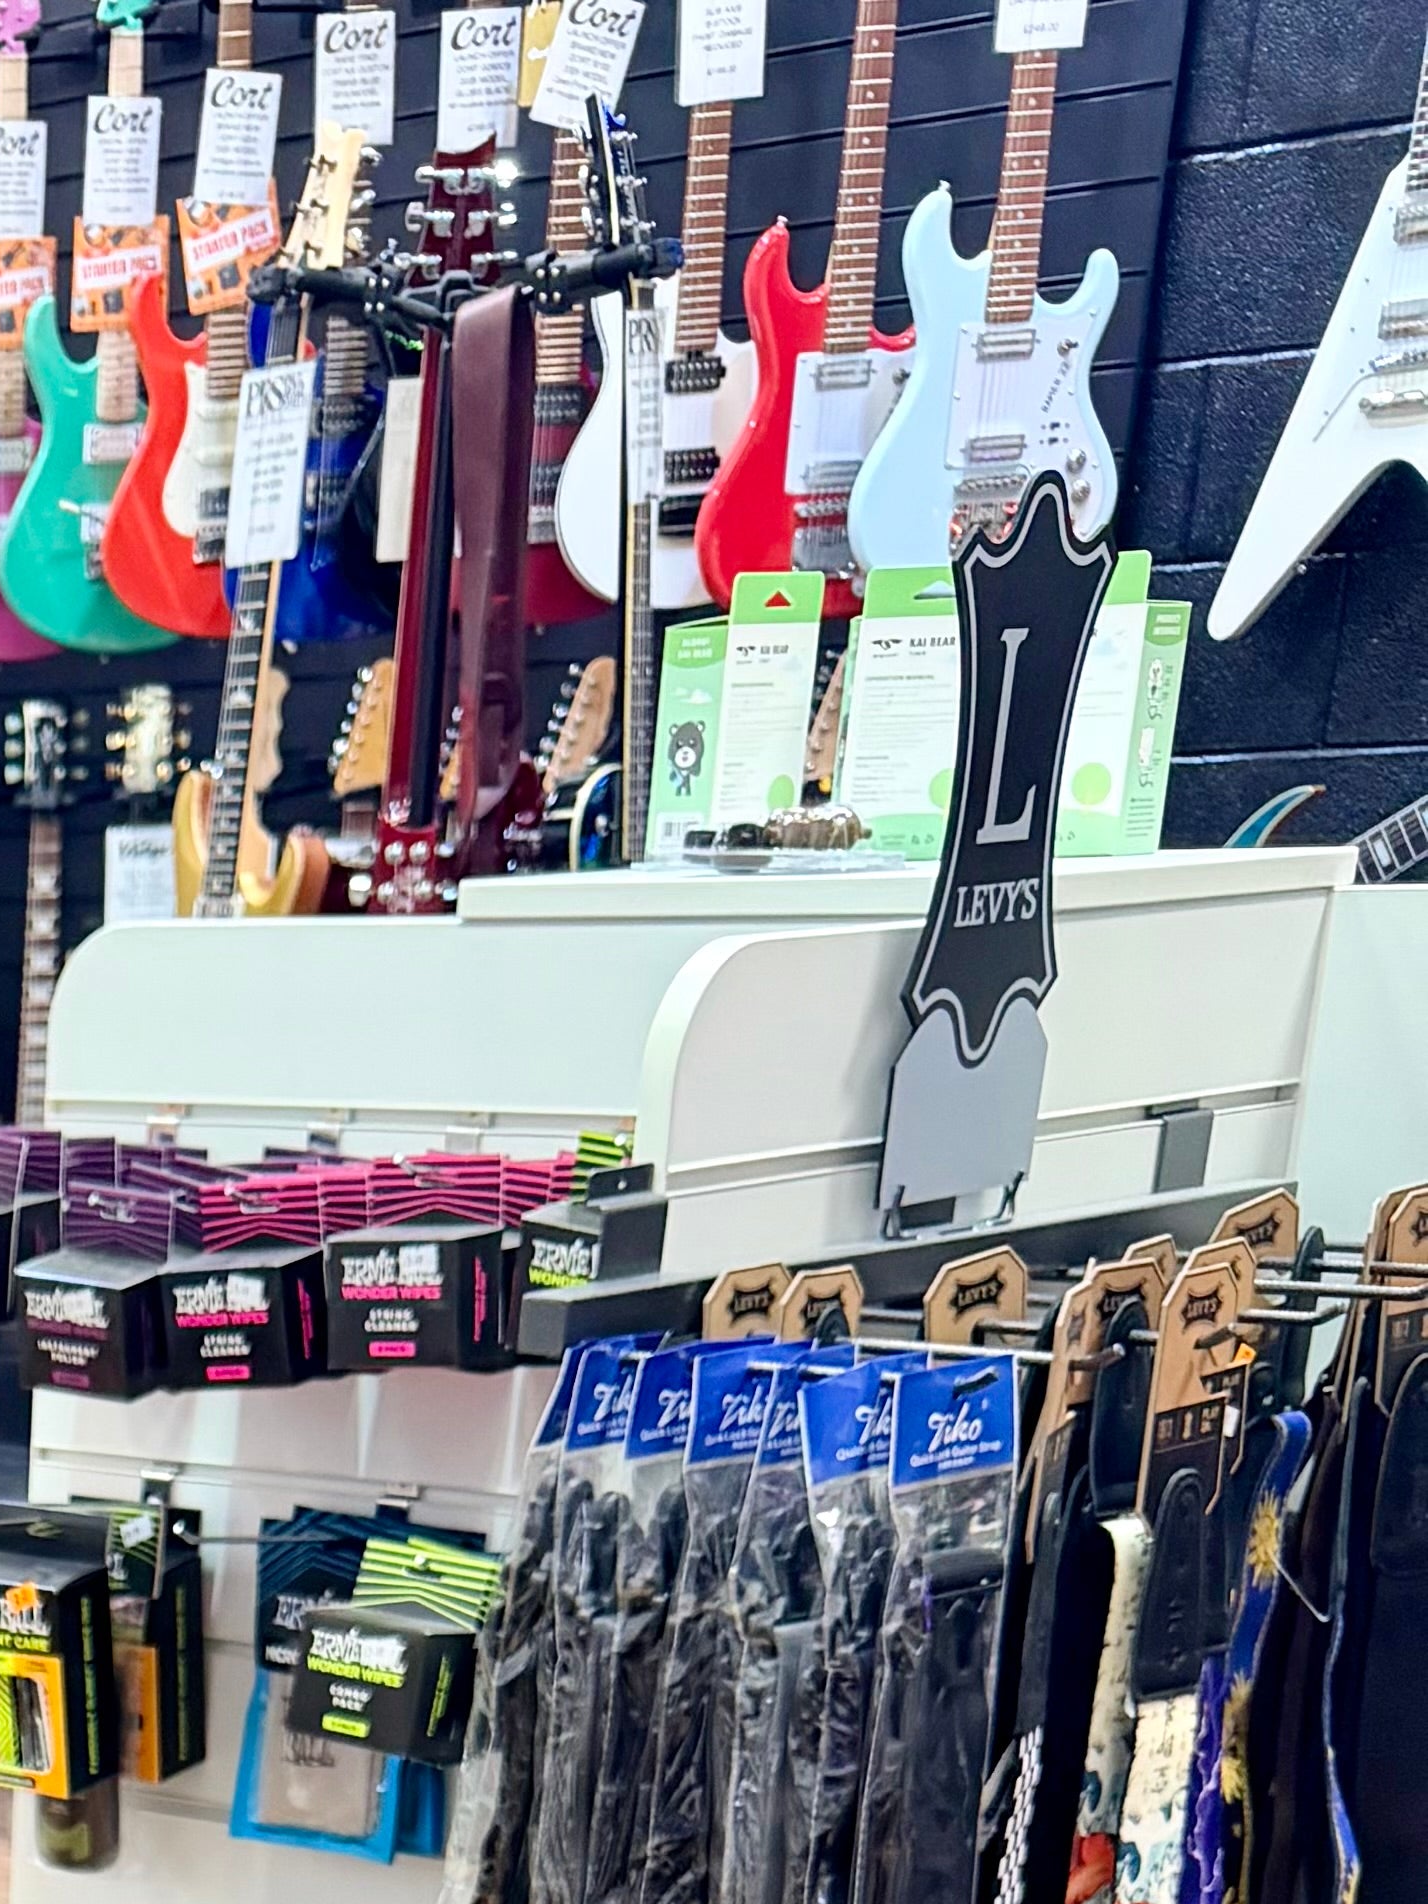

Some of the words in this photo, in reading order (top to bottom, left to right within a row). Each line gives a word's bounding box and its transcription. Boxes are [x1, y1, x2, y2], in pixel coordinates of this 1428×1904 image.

[324, 20, 388, 53] Cort
[451, 16, 517, 51] Cort
[569, 0, 637, 37] Cort
[210, 75, 273, 110] Cort
[94, 103, 153, 134] Cort
[909, 637, 928, 648] KAI
[930, 636, 956, 647] BEAR
[976, 627, 1037, 845] L
[953, 877, 1040, 928] LEVY'S
[341, 1249, 399, 1286] ERNIE
[532, 1237, 591, 1274] ERNIE
[341, 1286, 397, 1300] WONDER
[398, 1285, 442, 1300] WIPES
[957, 1284, 999, 1307] LEVY'S
[592, 1373, 633, 1423] Tik
[719, 1382, 762, 1431] Tik
[855, 1396, 892, 1445] Tik
[927, 1400, 983, 1452] Tiko
[13, 1634, 49, 1653] CARE
[311, 1627, 361, 1664] ERNIE
[307, 1653, 361, 1680] WONDER
[361, 1664, 405, 1688] WIPES
